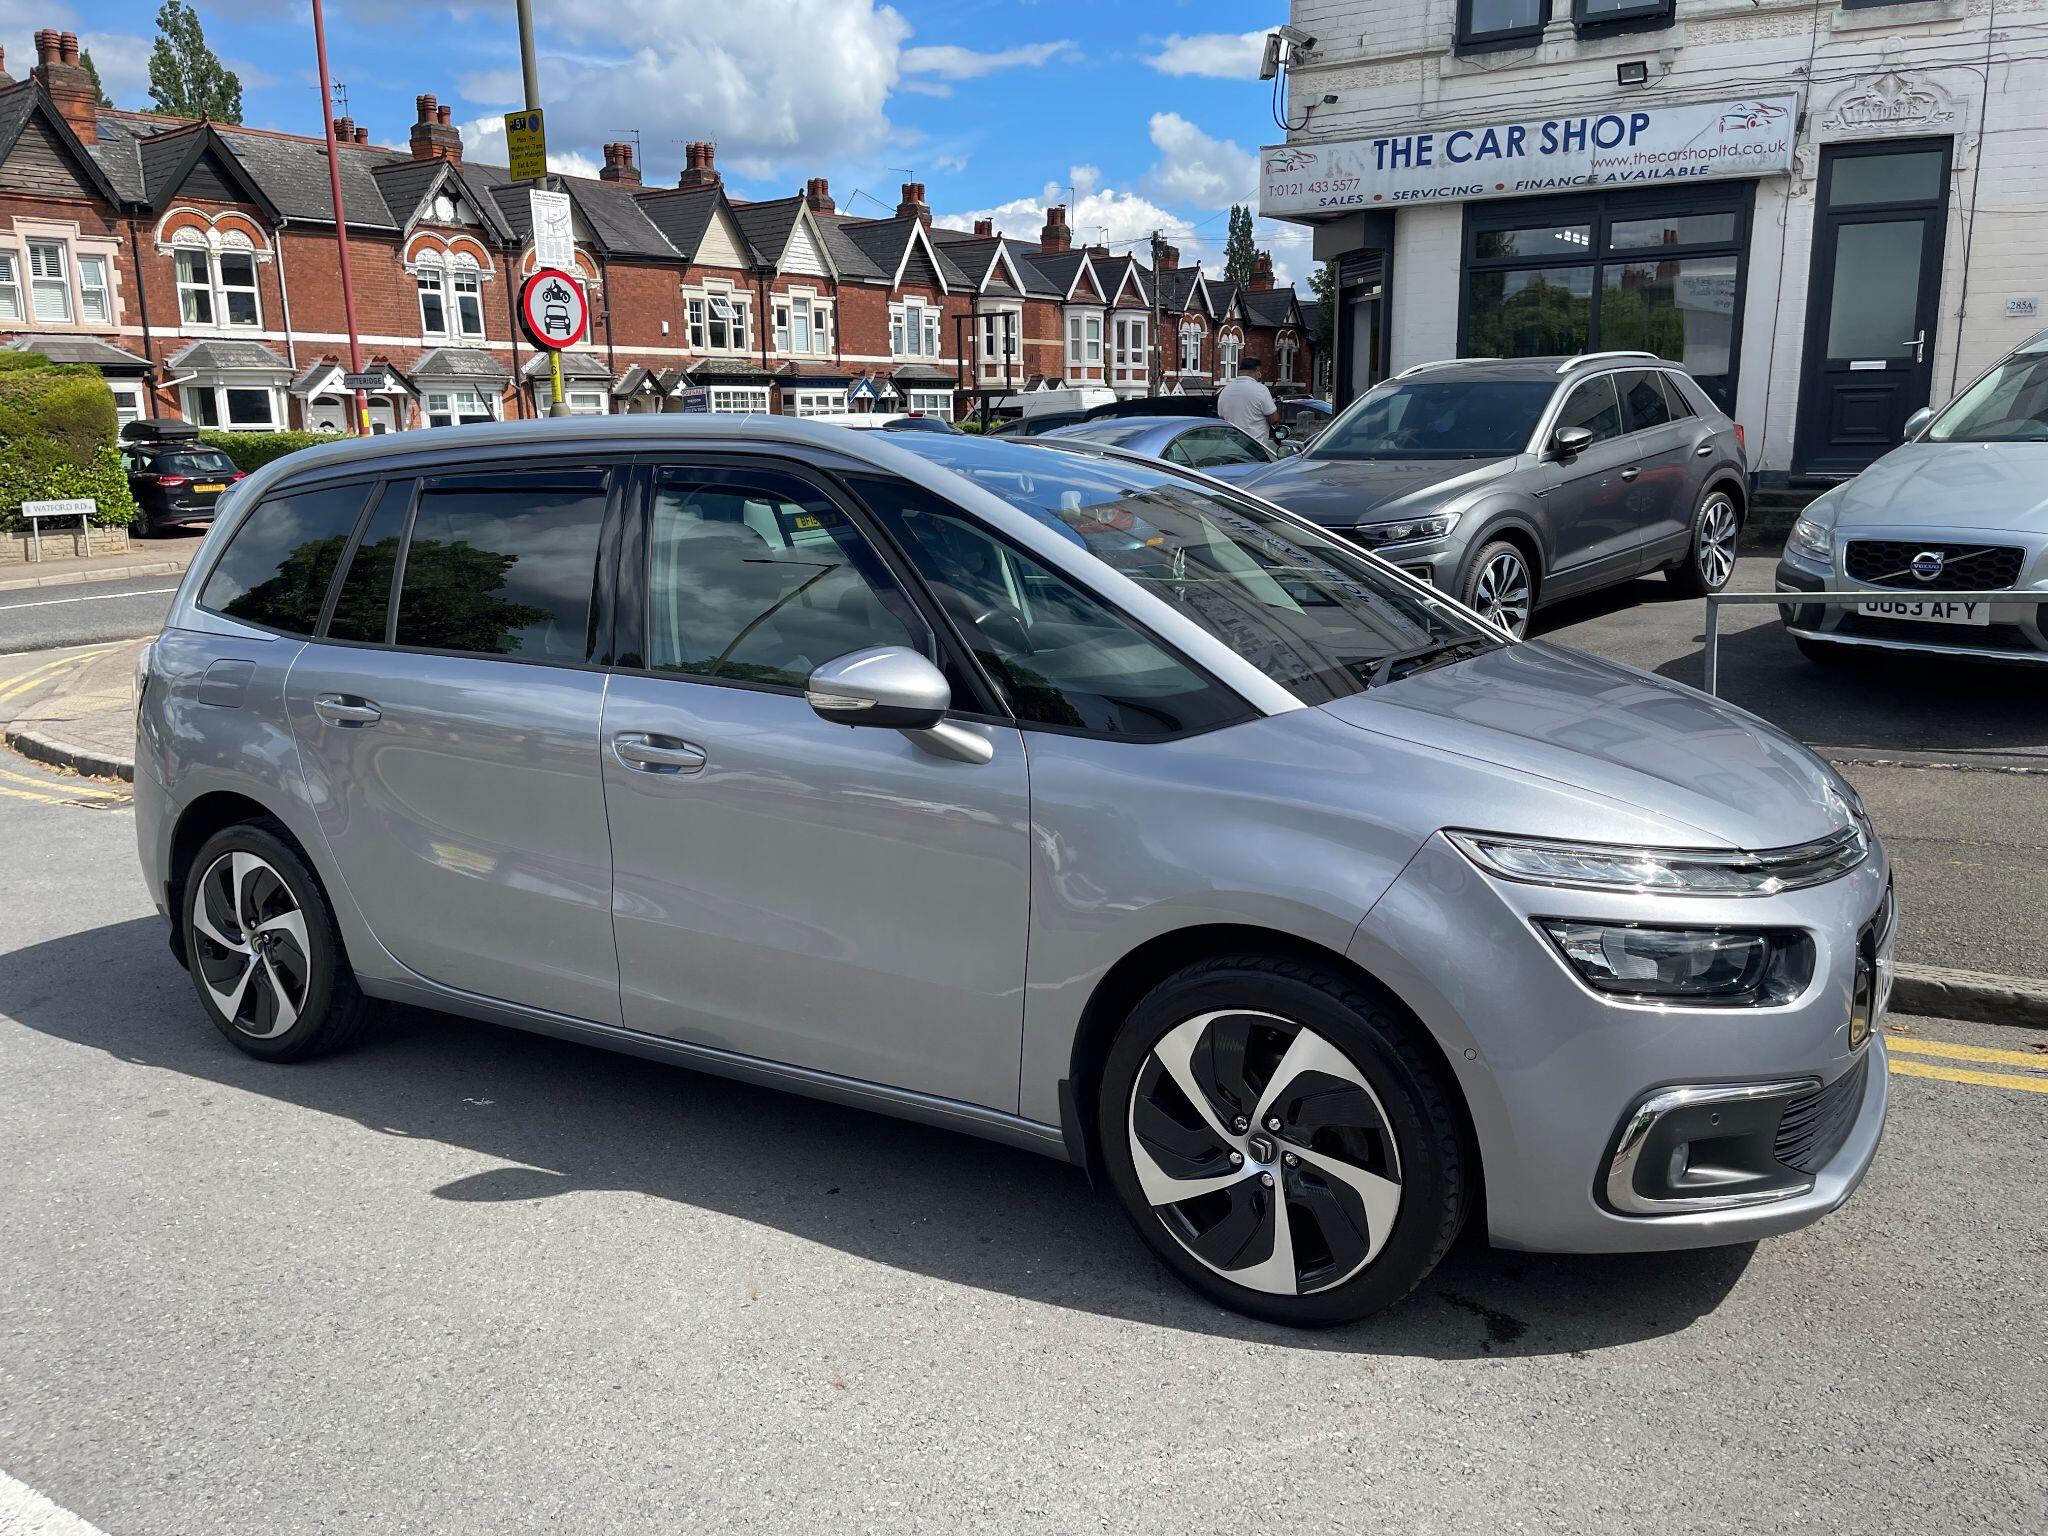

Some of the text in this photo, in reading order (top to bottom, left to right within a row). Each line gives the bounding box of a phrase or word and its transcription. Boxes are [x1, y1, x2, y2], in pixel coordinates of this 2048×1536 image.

[1373, 113, 1650, 170] THE CAR SHOP
[1590, 139, 1786, 168] www.thecarshopltd.co.uk
[1269, 178, 1361, 198] T:0121 433 5577
[1318, 165, 1710, 207] SALES SERVICING FINANCE AVAILABLE
[2010, 301, 2033, 310] 285A
[33, 503, 73, 513] WATFORD
[74, 502, 87, 510] RD
